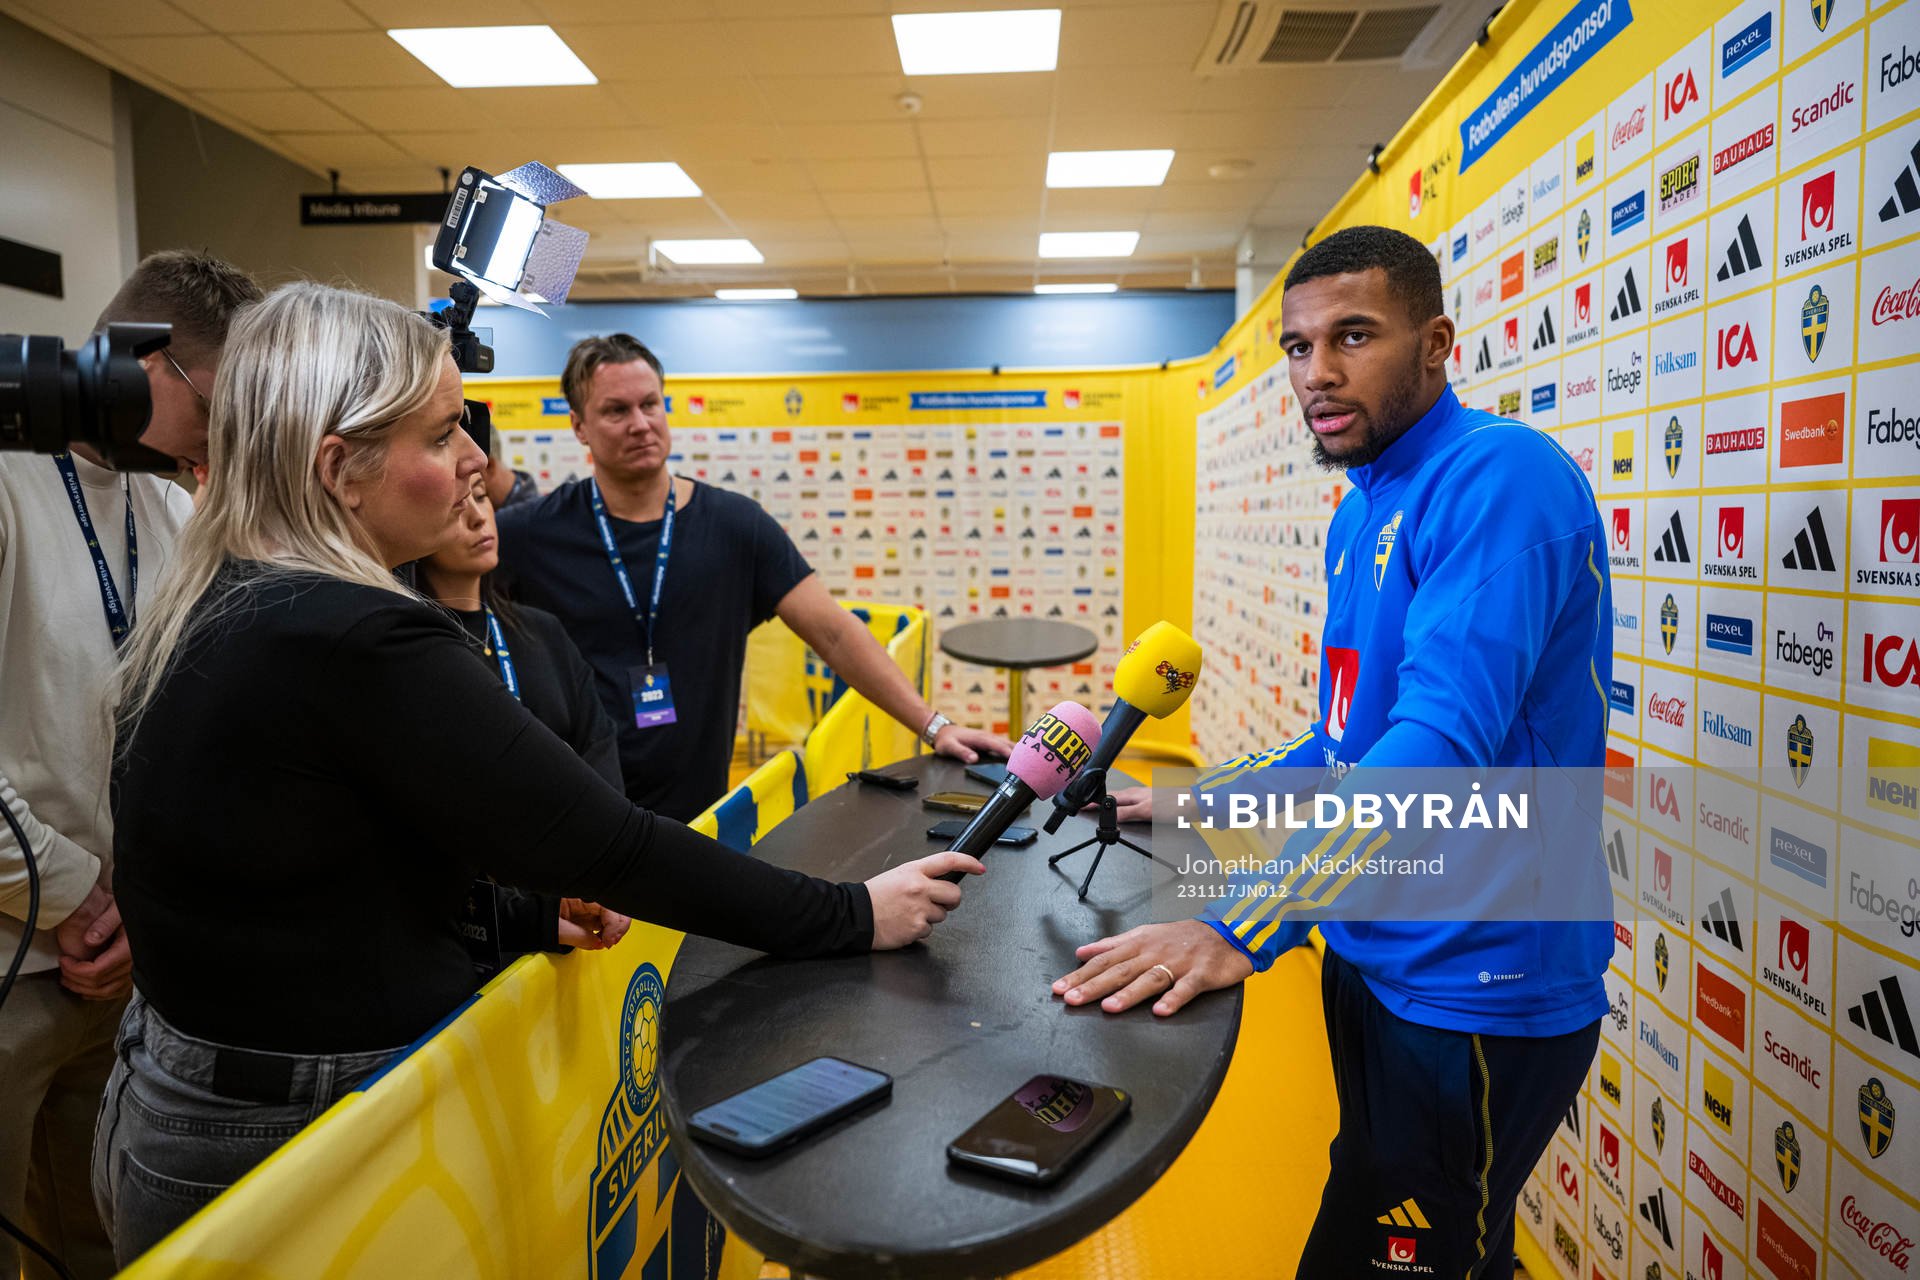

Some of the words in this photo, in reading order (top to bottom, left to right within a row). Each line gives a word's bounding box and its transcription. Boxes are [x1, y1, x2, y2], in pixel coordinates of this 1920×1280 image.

[1468, 84, 1520, 151] Fotbollens
[1520, 0, 1614, 102] huvudsponsor
[1664, 67, 1699, 121] ICA
[1791, 81, 1854, 133] Scandic
[1714, 125, 1773, 174] BAUHAUS
[1660, 156, 1699, 199] SPORT
[1784, 244, 1826, 268] SVENSKA
[1828, 232, 1852, 252] SPEL
[1654, 295, 1682, 314] SVENSKA
[1683, 288, 1700, 305] SPEL
[1654, 351, 1697, 376] Folksam
[1717, 321, 1758, 371] ICA
[1566, 376, 1597, 399] Scandic
[1607, 367, 1642, 394] Fabege
[1706, 427, 1765, 455] BAUHAUS
[1785, 426, 1825, 441] Swedbank
[1626, 557, 1639, 568] SPEL
[1704, 563, 1737, 577] SVENSKA
[1739, 565, 1757, 579] SPEL
[1857, 570, 1912, 587] SVENSKA
[1776, 630, 1833, 676] Fabege
[1863, 632, 1920, 689] ICA
[1611, 685, 1629, 699] exel
[1648, 692, 1687, 728] Coca-Cola
[1703, 711, 1752, 747] Folksam
[1650, 773, 1681, 823] ICA
[1700, 802, 1749, 845] Scandic
[1642, 891, 1667, 914] SVENSKA
[1668, 908, 1686, 926] SPEL
[1700, 987, 1732, 1018] Swedbank
[1763, 967, 1802, 1001] SVENSKA
[1804, 992, 1827, 1016] SPEL
[1640, 1020, 1679, 1072] Folksam
[1764, 1030, 1821, 1090] Scandic
[608, 1118, 662, 1209] SVERI
[1557, 1155, 1579, 1208] ICA
[1689, 1151, 1744, 1220] BAUHAUS
[1761, 1227, 1800, 1273] Swedbank
[1841, 1195, 1915, 1273] Coca-Cola
[1371, 1258, 1410, 1272] SVENSKA
[1412, 1265, 1434, 1273] SPEL
